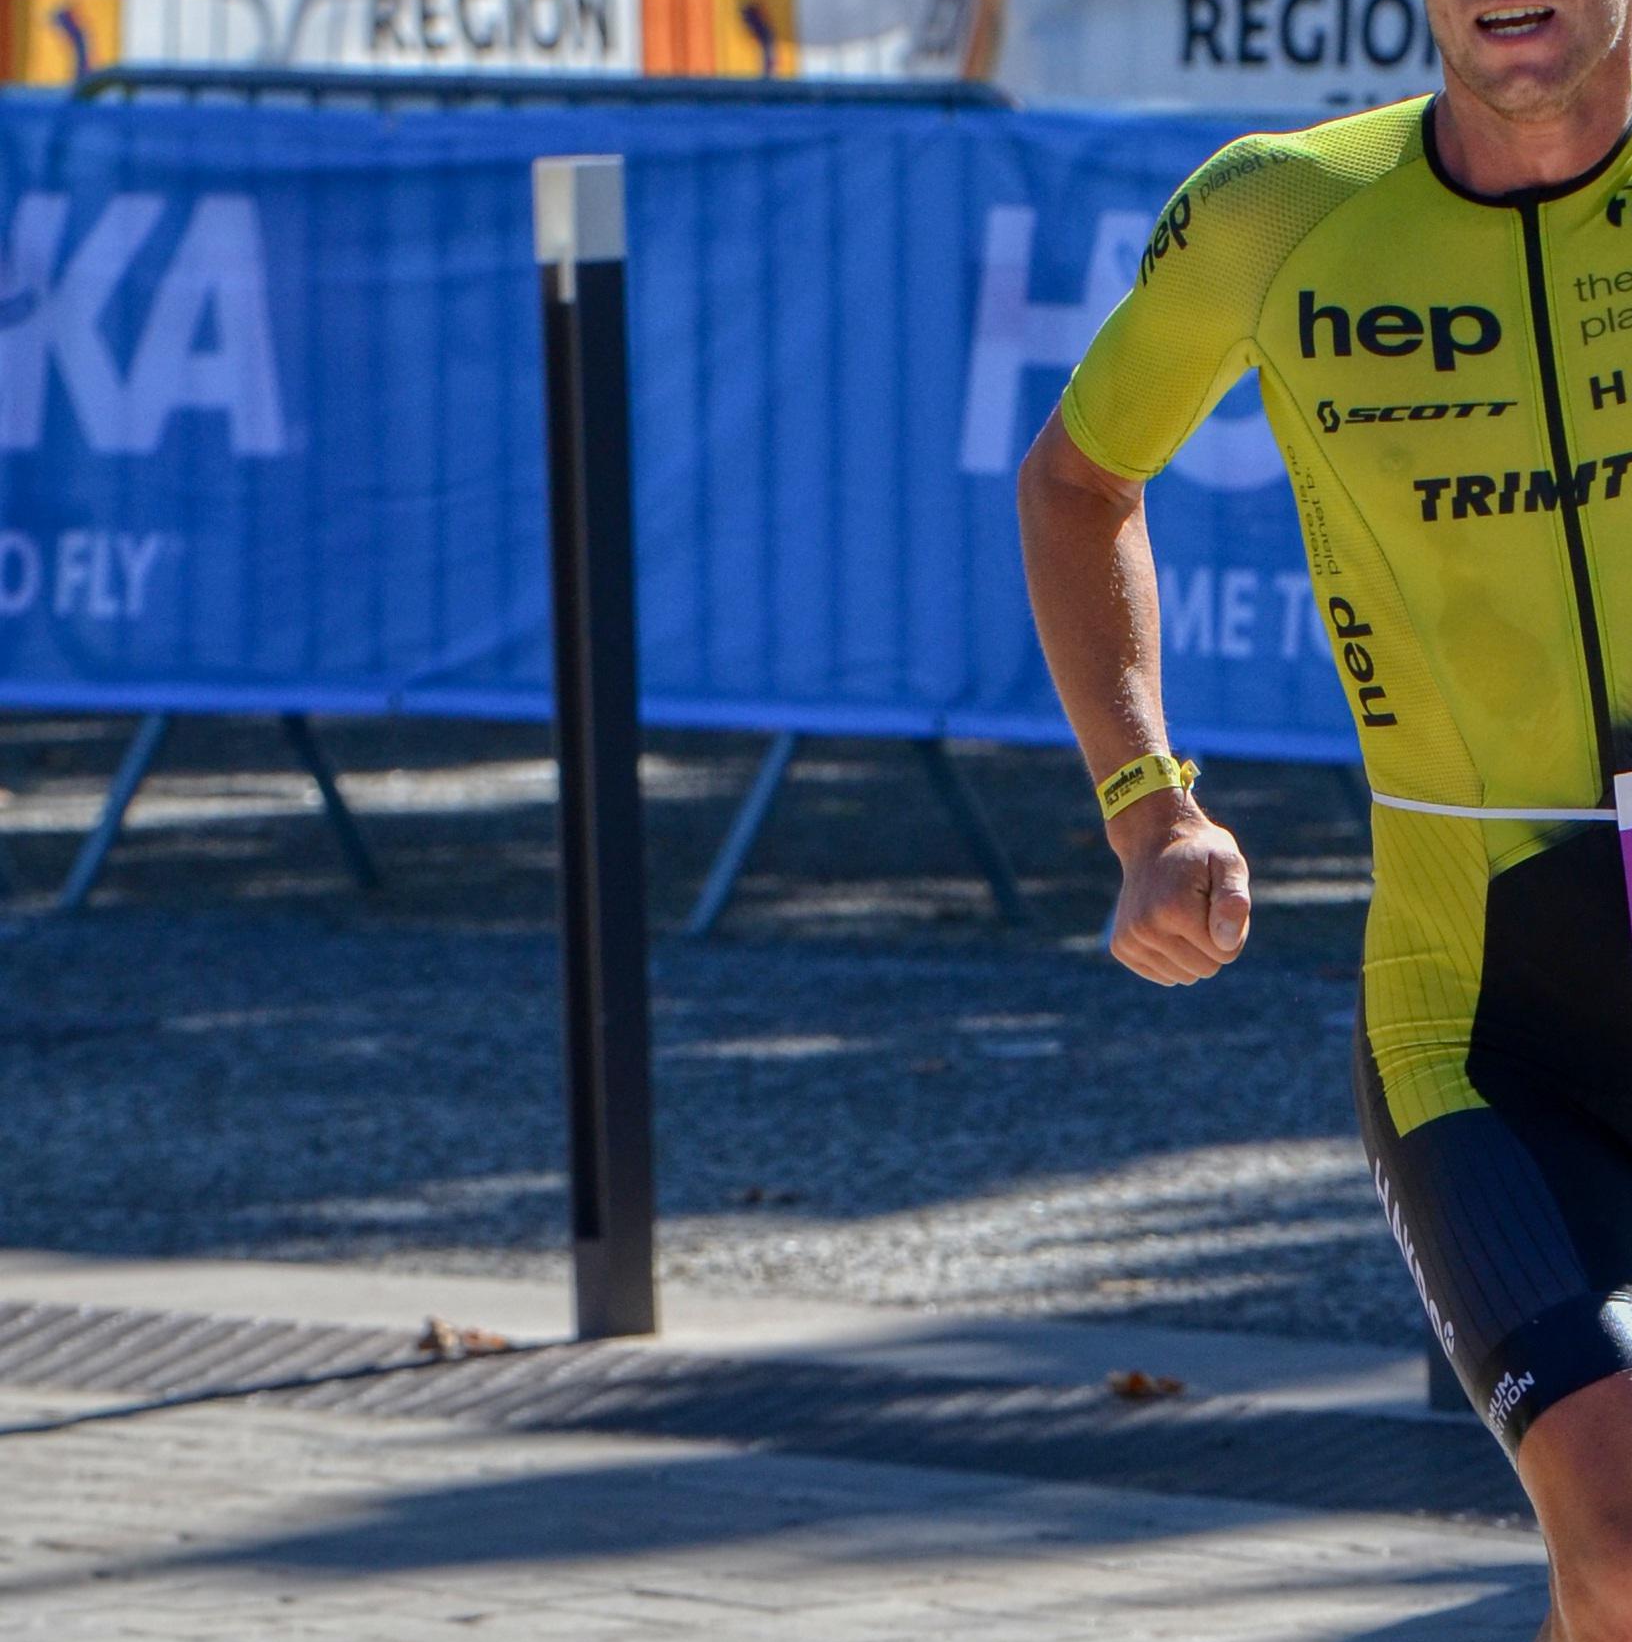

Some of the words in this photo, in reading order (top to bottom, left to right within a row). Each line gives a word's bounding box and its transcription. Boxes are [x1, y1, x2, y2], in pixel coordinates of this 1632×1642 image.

[0, 192, 289, 454] KA
[1298, 290, 1503, 372] hep
[1344, 400, 1518, 425] SCOTT
[54, 531, 160, 621] FLY
[1310, 498, 1343, 576] planet
[1328, 596, 1399, 728] hep
